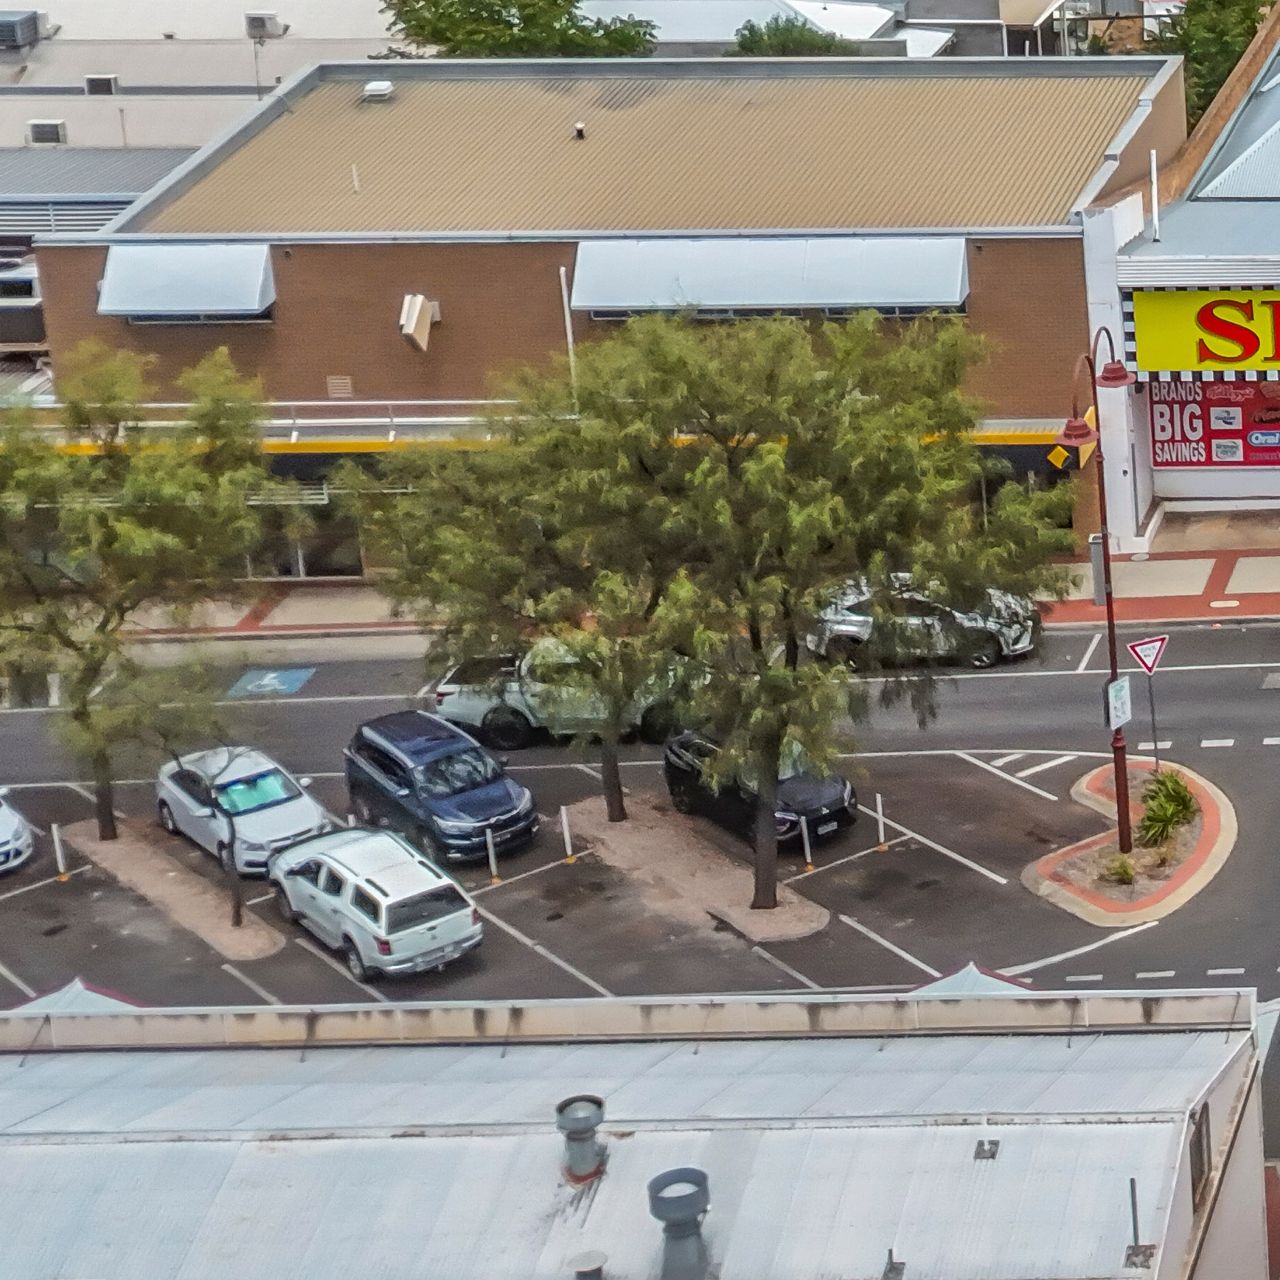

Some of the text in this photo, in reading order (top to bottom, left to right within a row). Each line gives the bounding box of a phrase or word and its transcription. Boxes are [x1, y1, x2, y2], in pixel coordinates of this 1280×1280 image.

[1151, 381, 1203, 402] BRANDS
[1152, 403, 1204, 441] BIG
[1154, 441, 1207, 462] SAVINGS
